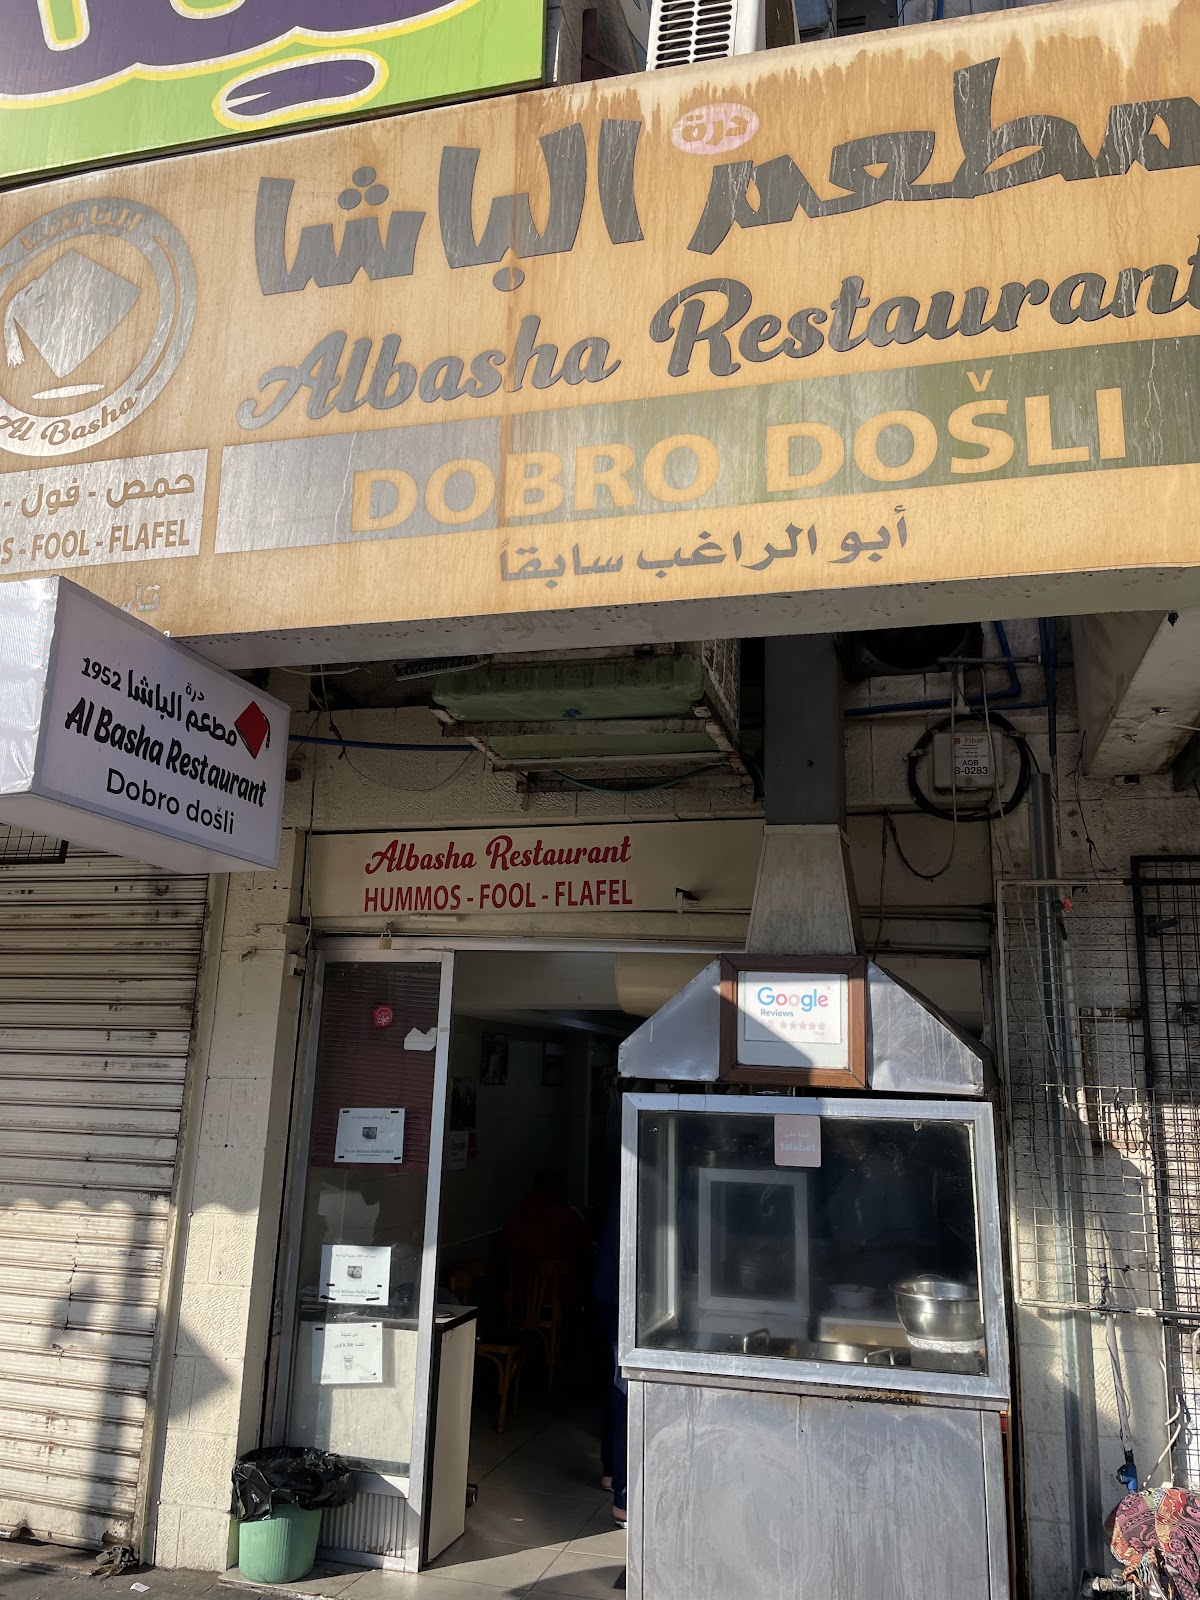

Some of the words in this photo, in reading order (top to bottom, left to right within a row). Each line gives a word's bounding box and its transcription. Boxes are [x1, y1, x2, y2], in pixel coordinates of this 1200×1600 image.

[682, 115, 749, 146] درة
[687, 57, 1200, 255] مطعم
[254, 118, 645, 296] الباشا
[236, 314, 622, 430] Albasha
[41, 394, 138, 446] Basha
[351, 432, 721, 534] DOBRO
[765, 368, 1127, 493] DOŠLI
[21, 476, 81, 518] فول
[106, 473, 195, 509] حمص
[31, 529, 90, 561] FOOL
[108, 518, 190, 554] FLAFEL
[636, 522, 818, 579] الراغب
[828, 504, 908, 564] أبو
[81, 656, 122, 692] 1952
[127, 669, 183, 721] الباشا
[185, 682, 205, 703] درة
[186, 709, 238, 747] مطعم
[64, 697, 95, 737] Al
[93, 706, 165, 766] Basha
[165, 738, 267, 808] Restaurant
[106, 767, 180, 815] Dobro
[186, 799, 235, 835] došli
[364, 839, 478, 874] Albasha
[485, 834, 632, 871] Restaurant
[364, 884, 461, 912] HUMMOS
[479, 882, 536, 909] FOOL
[555, 879, 633, 906] FLAFEL
[757, 986, 829, 1013] Google
[760, 1008, 794, 1018] Reviews
[779, 1141, 817, 1152] talabat
